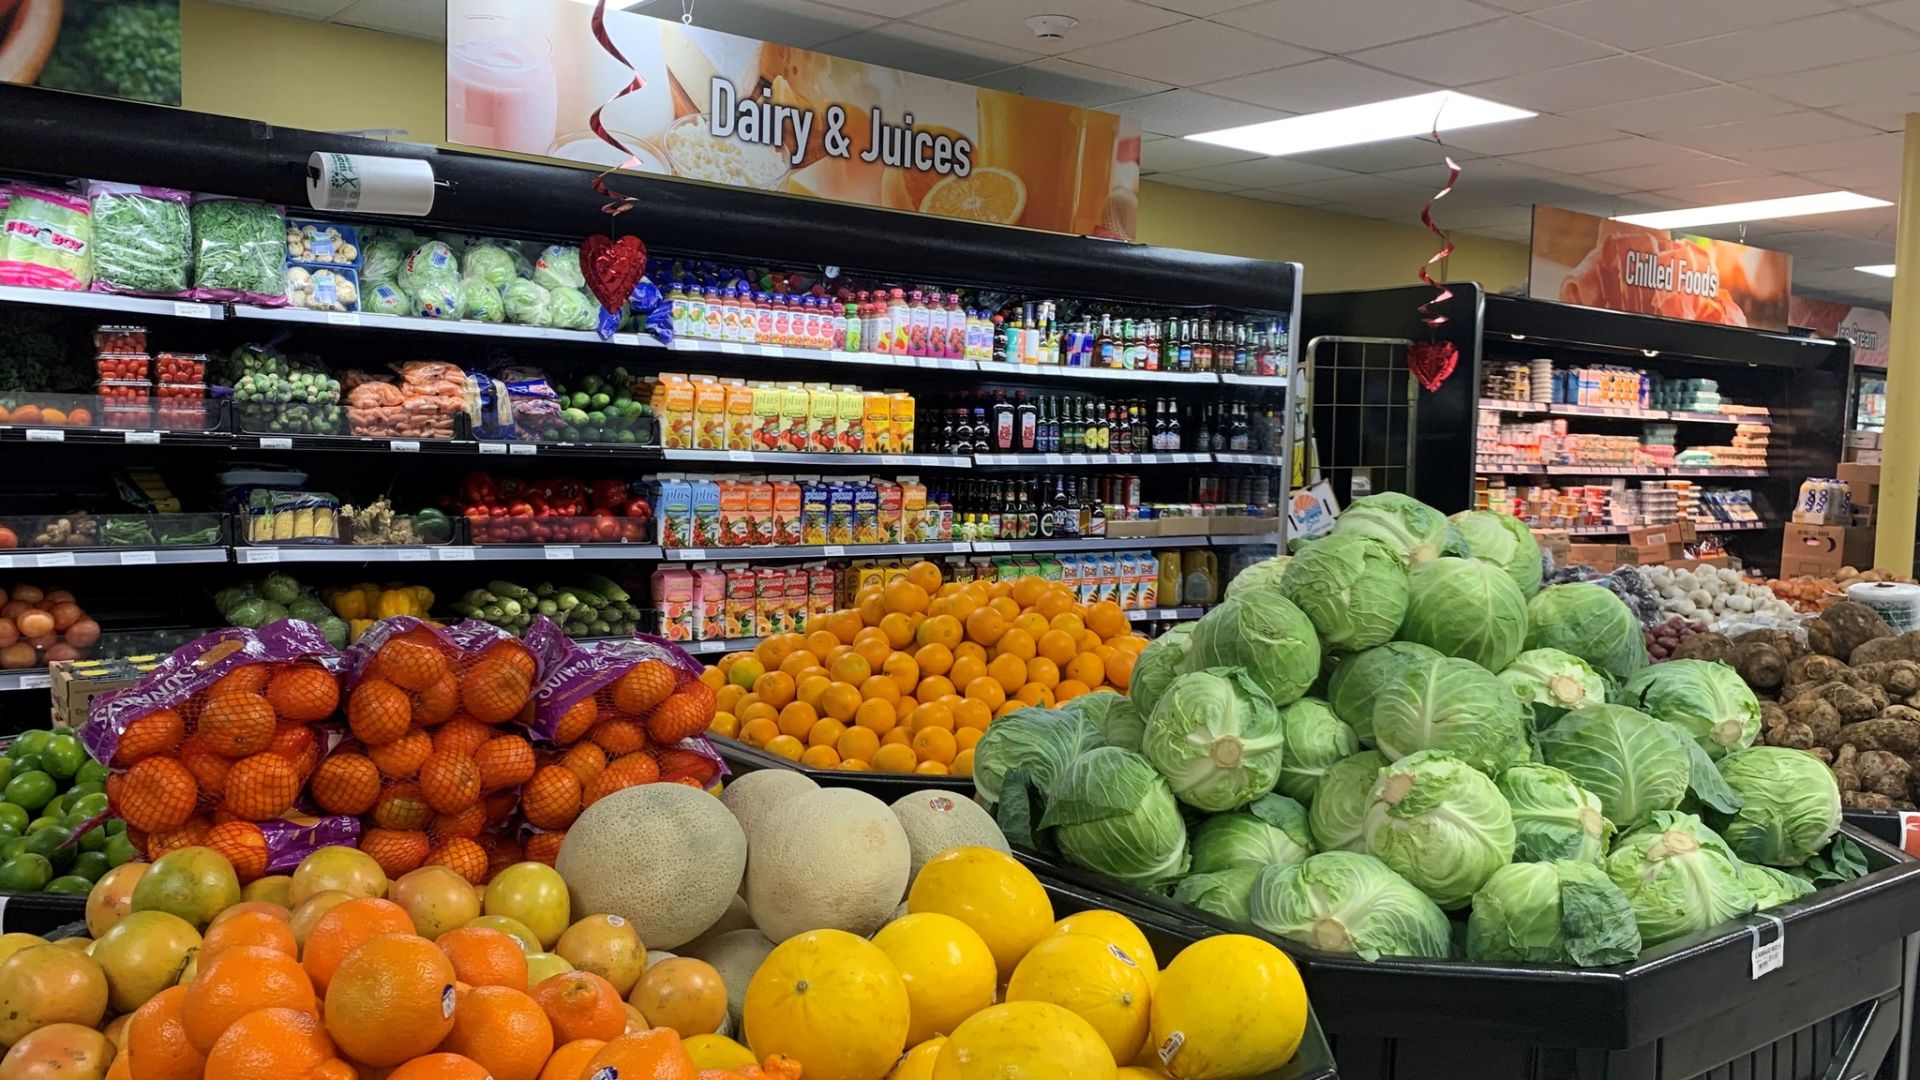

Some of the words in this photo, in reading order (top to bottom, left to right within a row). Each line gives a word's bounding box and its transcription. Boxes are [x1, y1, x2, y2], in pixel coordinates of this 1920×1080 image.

[711, 77, 813, 165] Dairy
[824, 105, 850, 158] &
[861, 108, 971, 177] Juices
[51, 233, 84, 252] BOY
[1626, 249, 1674, 292] Chilled
[1678, 259, 1718, 298] Foods
[1852, 321, 1878, 350] Cream
[95, 666, 197, 729] SUNRAYS
